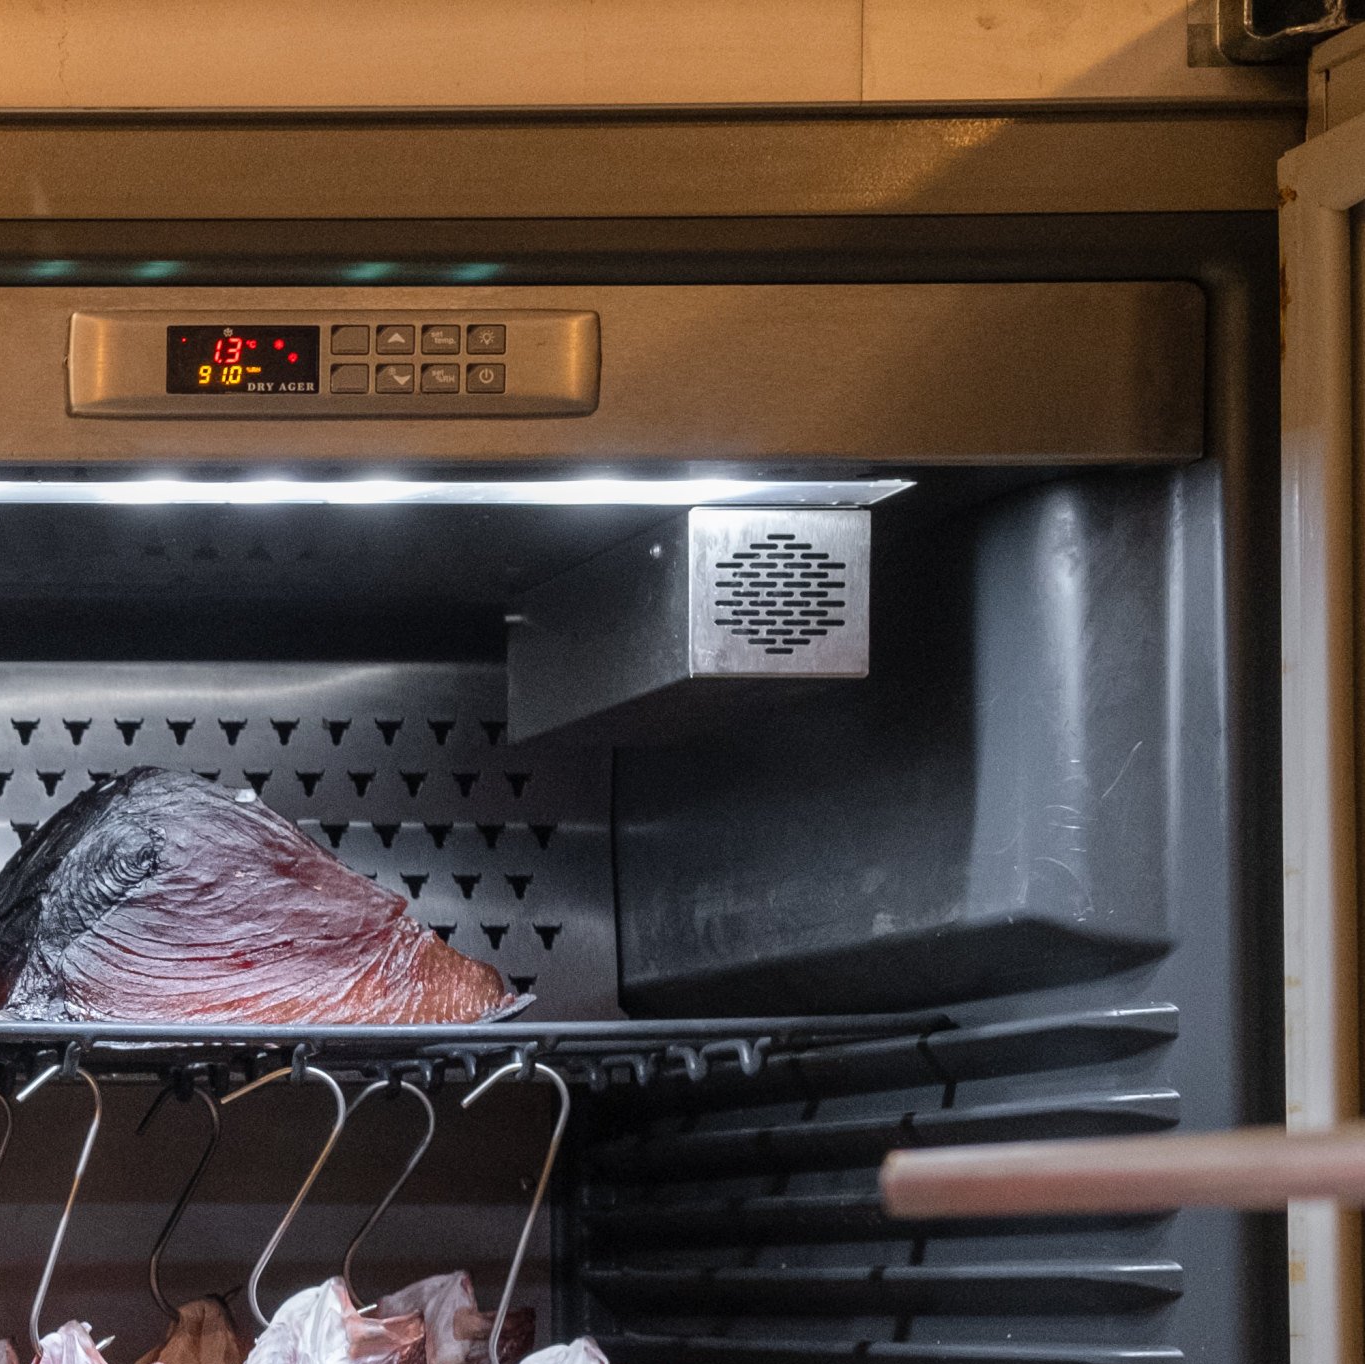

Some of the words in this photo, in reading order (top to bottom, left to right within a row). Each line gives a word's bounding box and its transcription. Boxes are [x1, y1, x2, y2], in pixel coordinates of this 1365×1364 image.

[434, 337, 456, 345] temp.
[213, 337, 243, 364] 1.3
[247, 382, 274, 391] DRY
[278, 382, 315, 391] AGER
